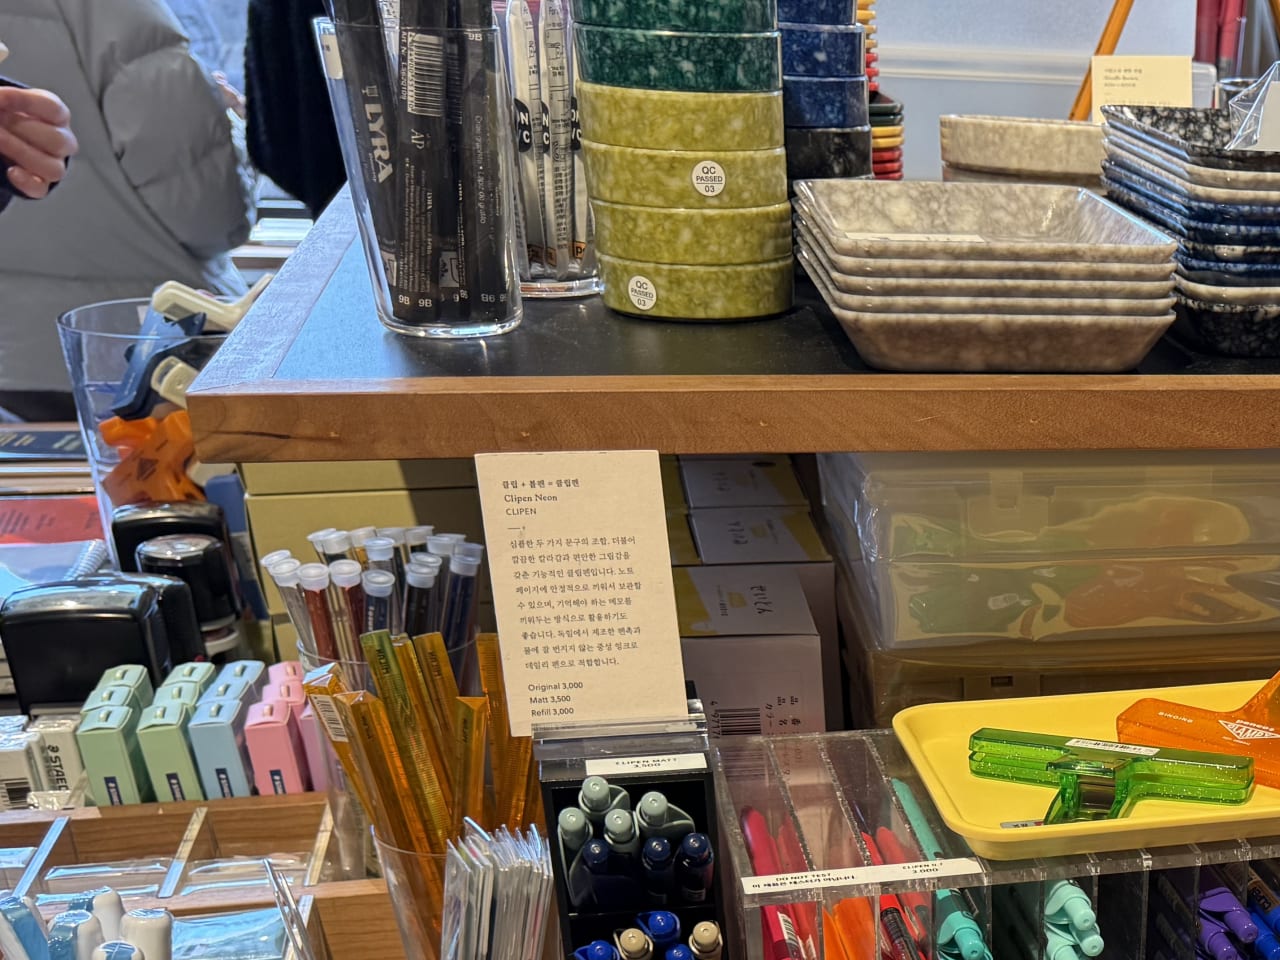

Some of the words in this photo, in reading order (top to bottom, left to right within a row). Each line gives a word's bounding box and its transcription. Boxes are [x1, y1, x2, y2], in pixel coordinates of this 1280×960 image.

[364, 103, 394, 184] LYRA
[702, 166, 716, 175] QC
[696, 175, 723, 183] PASSED
[704, 185, 716, 193] 03
[636, 281, 648, 290] QC
[631, 287, 654, 299] PASSED
[504, 494, 533, 504] Clipen
[535, 493, 558, 502] Neon
[505, 508, 537, 516] CLIPEN
[547, 538, 563, 548] 가지
[528, 682, 561, 693] Original
[562, 681, 584, 691] 3,000
[529, 696, 549, 705] Matt
[550, 695, 571, 704] 3,500
[531, 709, 551, 718] Refill
[552, 708, 575, 717] 3,000
